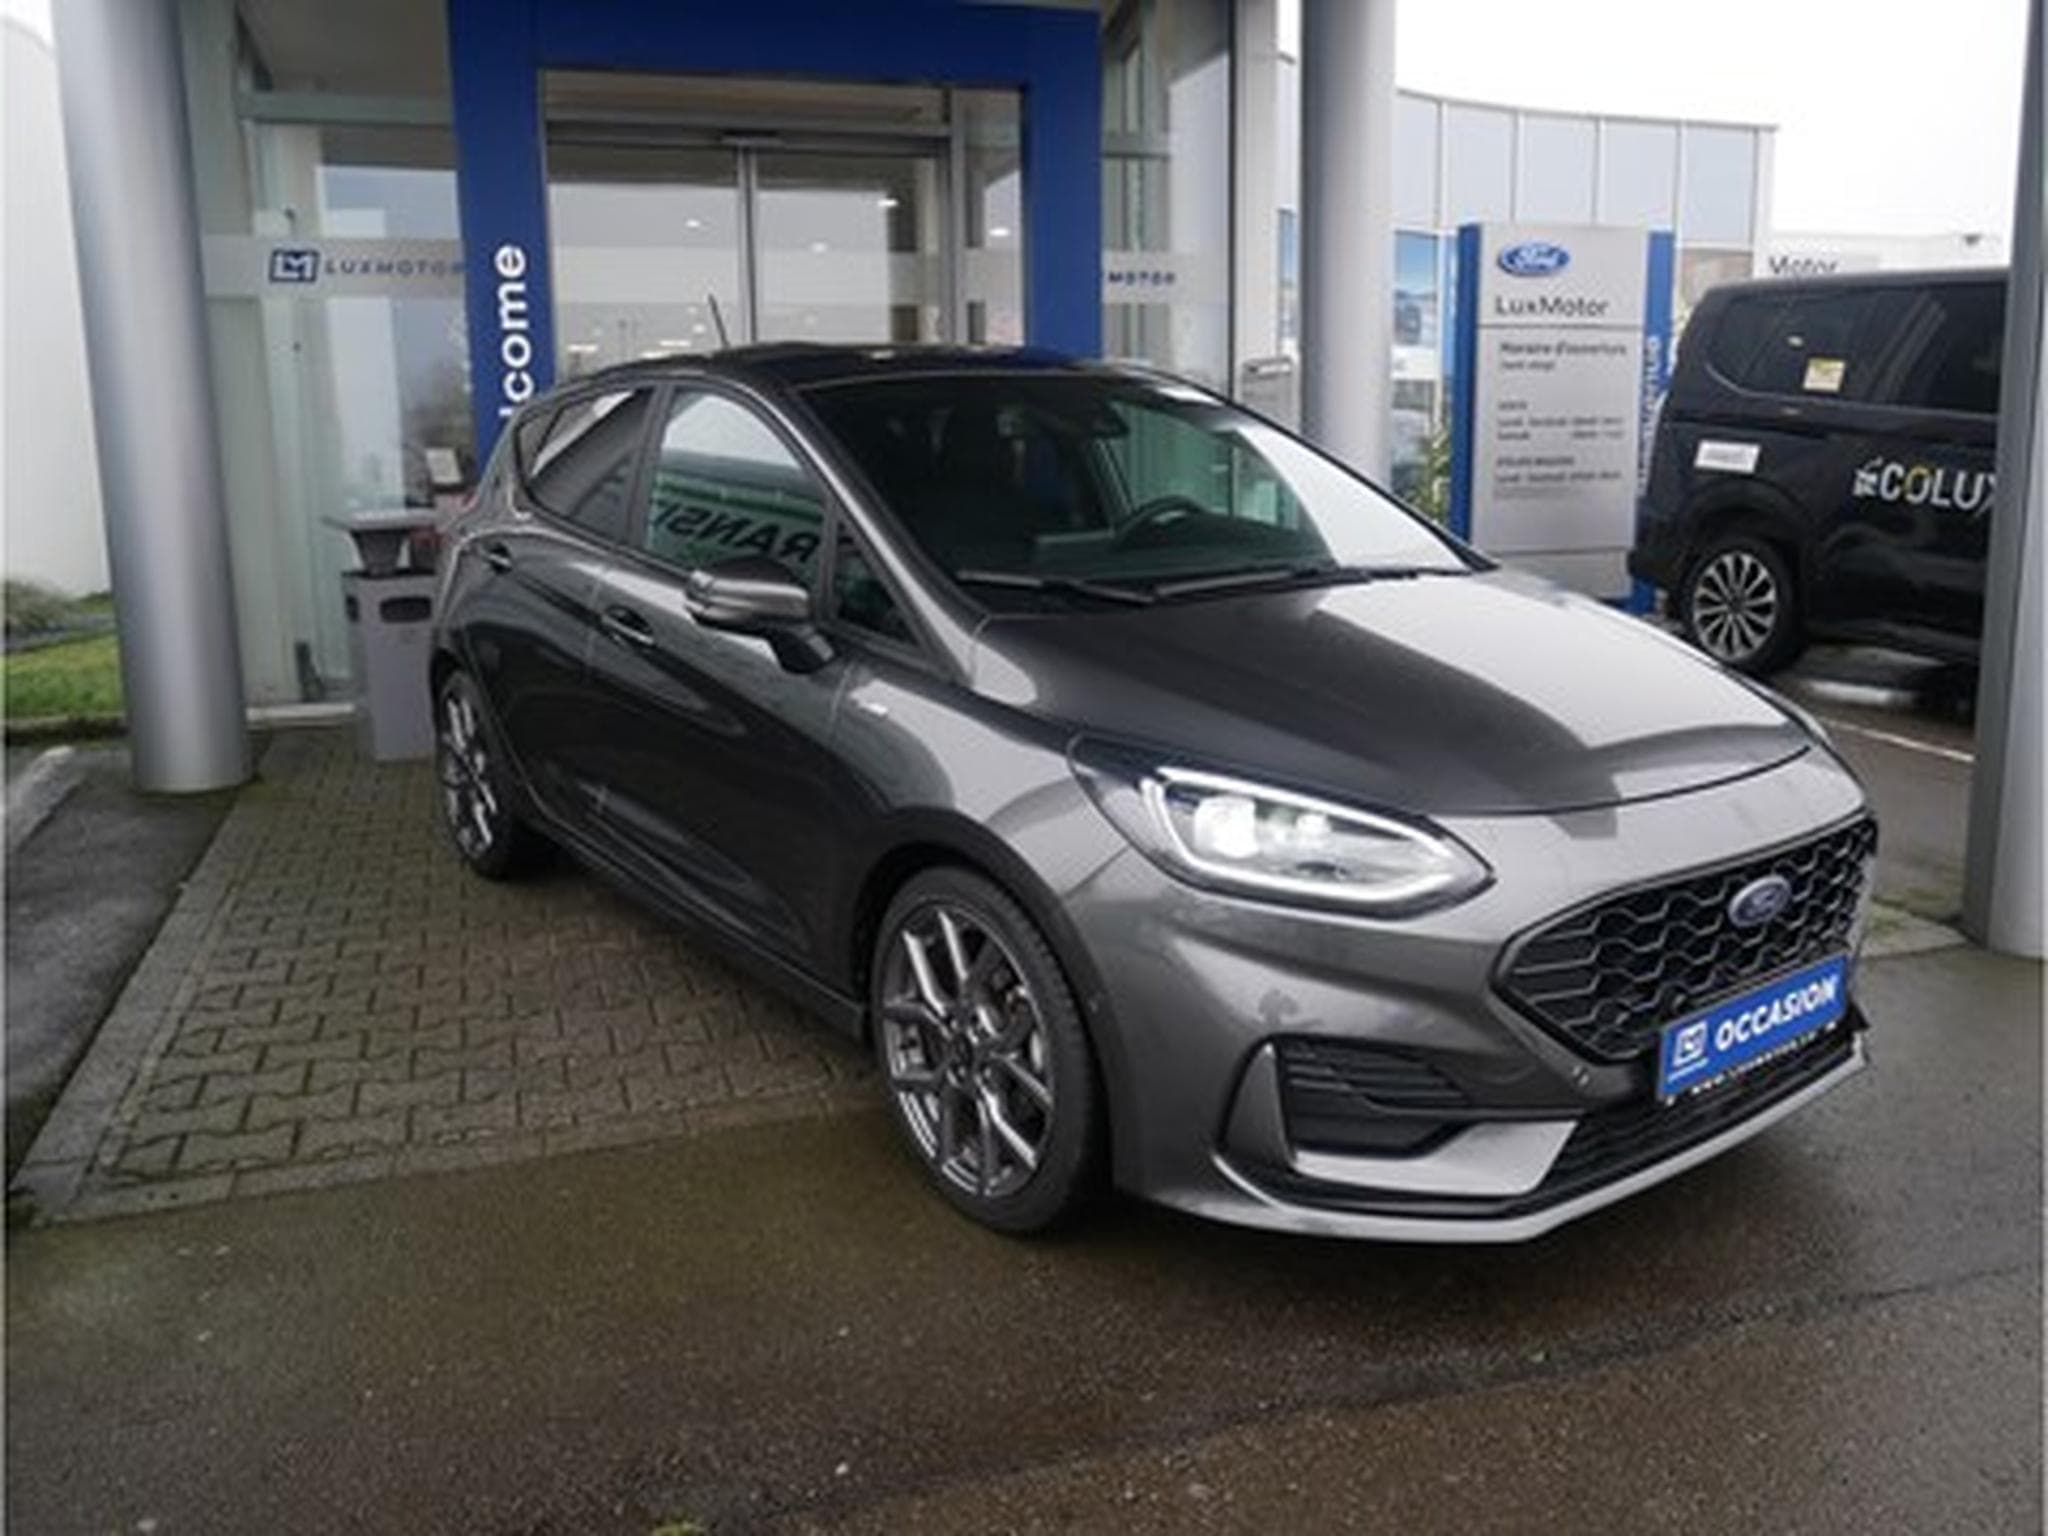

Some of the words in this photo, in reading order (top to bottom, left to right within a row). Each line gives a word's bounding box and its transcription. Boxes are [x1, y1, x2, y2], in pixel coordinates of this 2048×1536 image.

[1507, 245, 1563, 270] Ford
[1495, 295, 1609, 317] LuxMotor
[1713, 973, 1840, 1051] OCCASION
